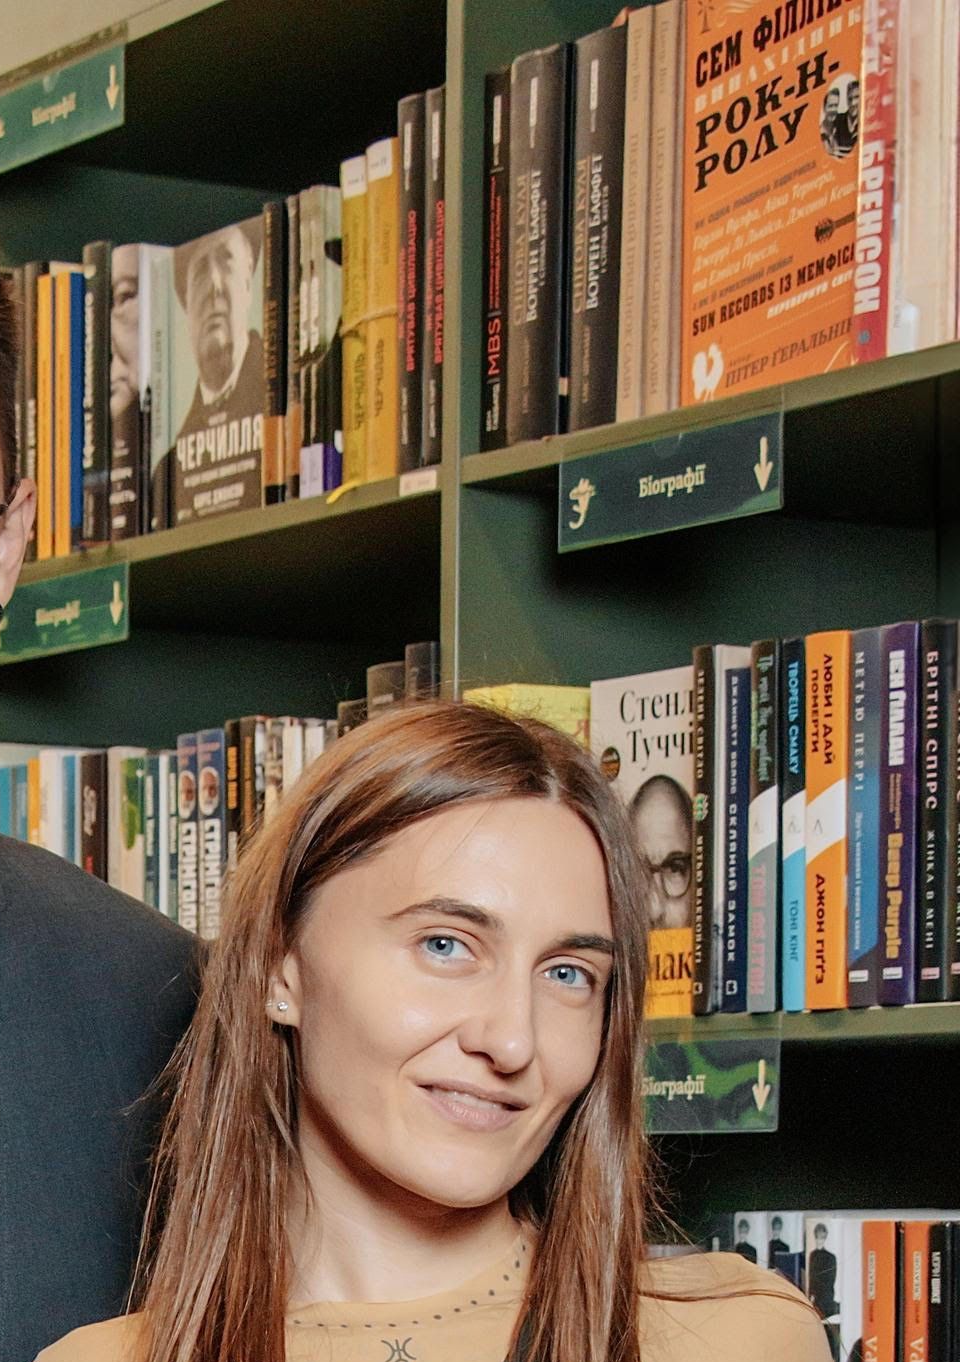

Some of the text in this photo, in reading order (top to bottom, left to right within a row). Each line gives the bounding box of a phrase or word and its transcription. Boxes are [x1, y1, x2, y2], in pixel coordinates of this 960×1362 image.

[696, 30, 742, 87] СЕМ
[753, 0, 855, 52] ФІЛЛІ
[695, 51, 840, 153] РОК-Н-
[694, 103, 809, 192] РОЛУ
[589, 153, 603, 227] БАФФЕТ
[526, 169, 542, 322] ВОРРЕН БАФФЕТ
[854, 139, 884, 315] БРЕНСОН
[586, 237, 600, 310] ВОРРЕН
[693, 310, 715, 337] SUN
[720, 282, 775, 324] RECORDS
[487, 319, 502, 376] MBS
[725, 357, 769, 388] ПІТЕР
[176, 414, 263, 472] ЧЕРЧИЛЛЯ
[639, 463, 707, 498] Біографії
[619, 690, 694, 725] Стенл
[811, 669, 820, 753] ПОМЕРТИ
[823, 654, 833, 704] ЛЮБИ
[788, 661, 799, 774] ТВОРЕЦЬ СМАКУ
[823, 725, 836, 765] ДАЙ
[854, 651, 864, 791] МЕТЬЮ ПЕРРІ
[926, 651, 939, 810] БРІТНІ СПІРС
[727, 803, 738, 962] СКЛЯНИЙ ЗАМОК
[926, 830, 935, 882] ЖІНКА
[815, 873, 826, 933] ДЖОН
[885, 832, 903, 959] Deep Purple
[925, 909, 934, 949] МЕНІ
[640, 1074, 707, 1101] Біографії
